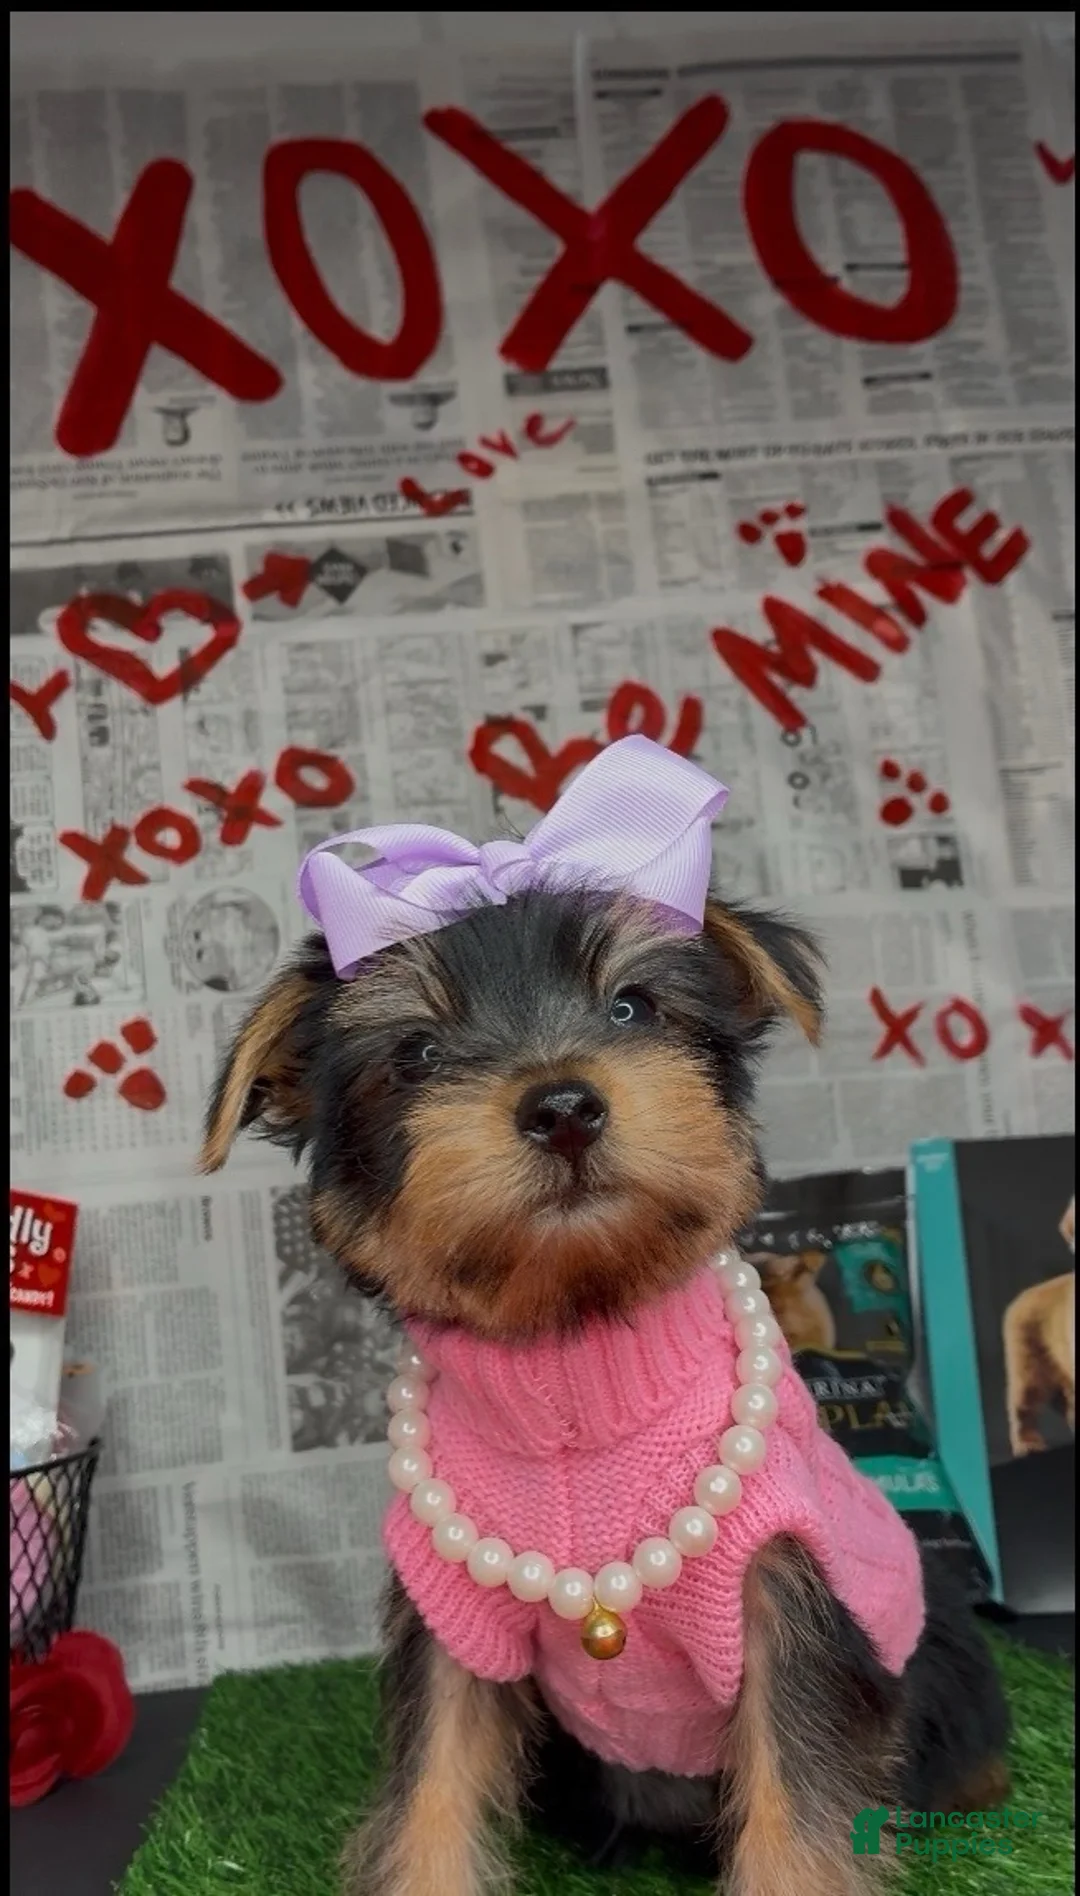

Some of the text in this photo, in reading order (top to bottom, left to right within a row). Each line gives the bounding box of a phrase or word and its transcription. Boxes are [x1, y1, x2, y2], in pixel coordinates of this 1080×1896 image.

[398, 410, 577, 518] Love
[710, 487, 1033, 735] MINE
[58, 744, 357, 905] XOXO
